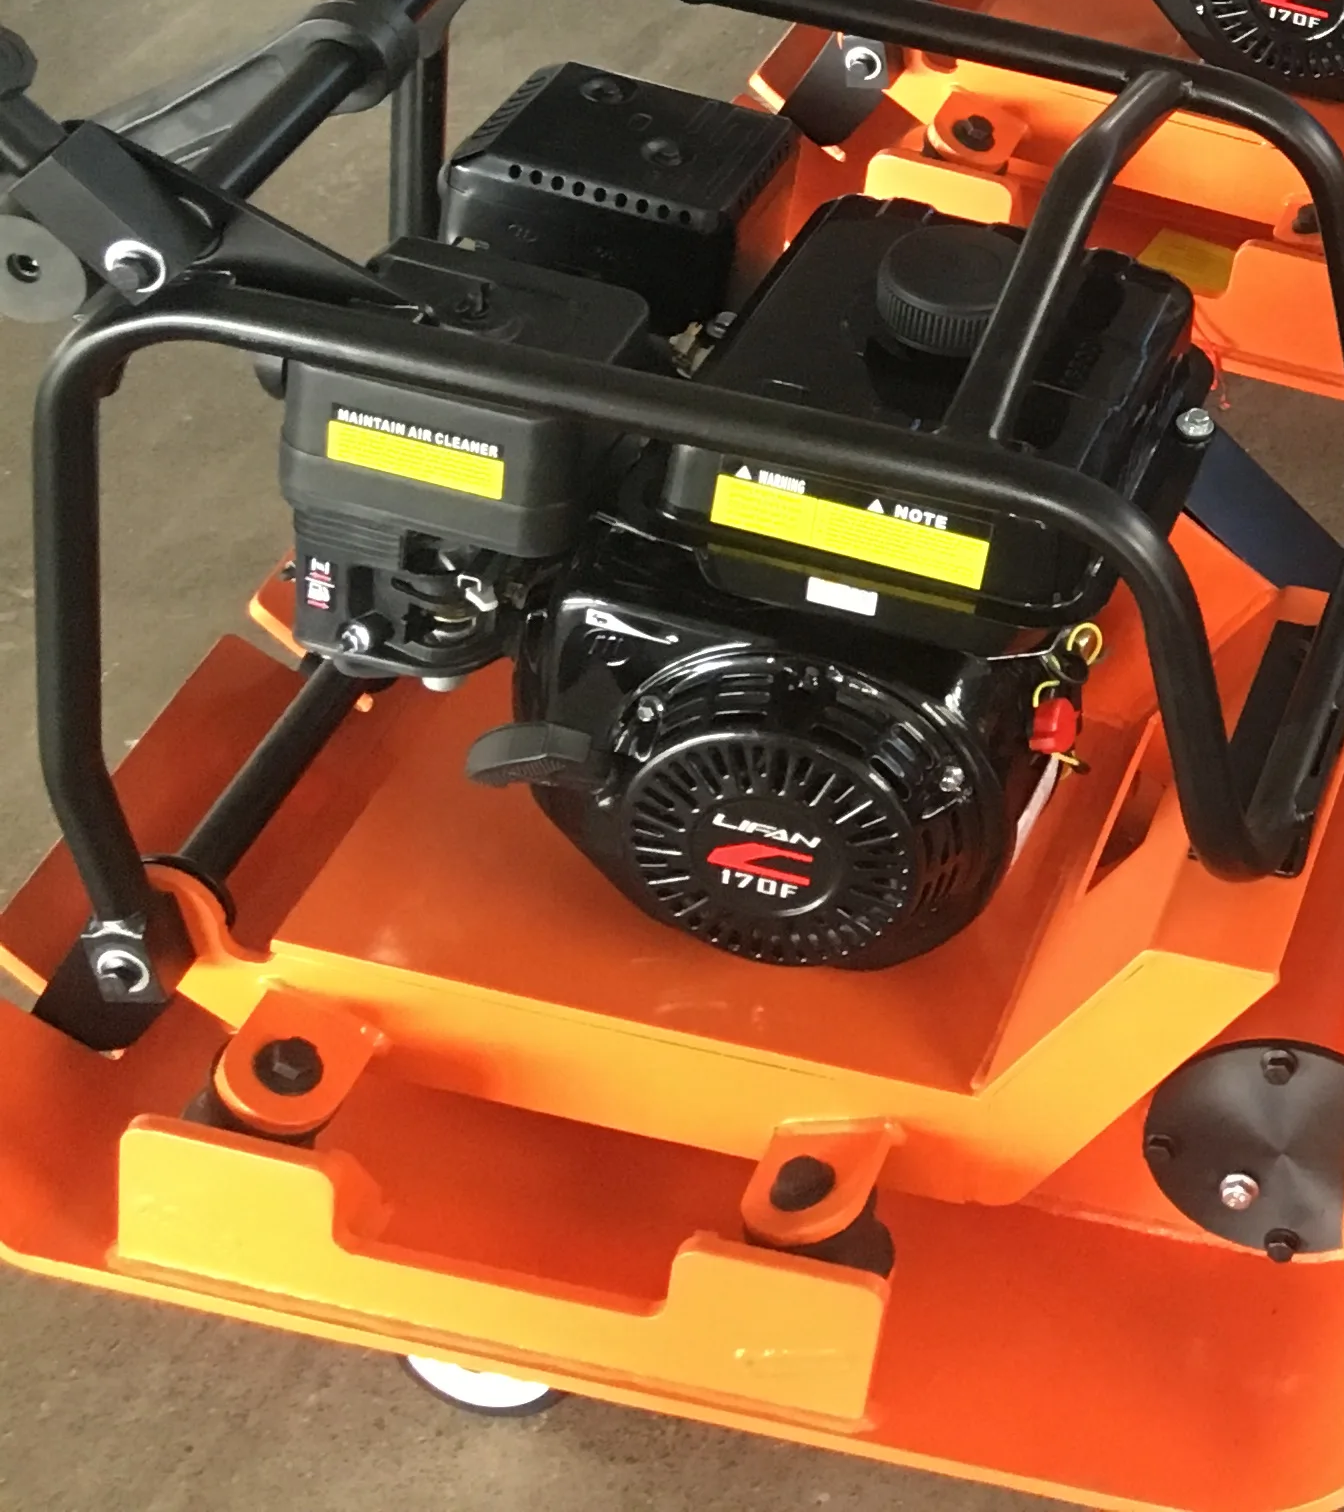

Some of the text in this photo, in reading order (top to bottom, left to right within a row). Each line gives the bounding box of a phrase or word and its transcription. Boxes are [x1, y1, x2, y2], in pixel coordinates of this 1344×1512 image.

[1269, 6, 1321, 28] 170F
[337, 408, 405, 436] MAINTAIN
[407, 425, 432, 442] AIR
[434, 432, 499, 458] CLEANER
[758, 469, 806, 495] WARNING
[894, 504, 948, 530] NOTE
[712, 813, 822, 849] LIFAN
[721, 868, 799, 899] 170F
